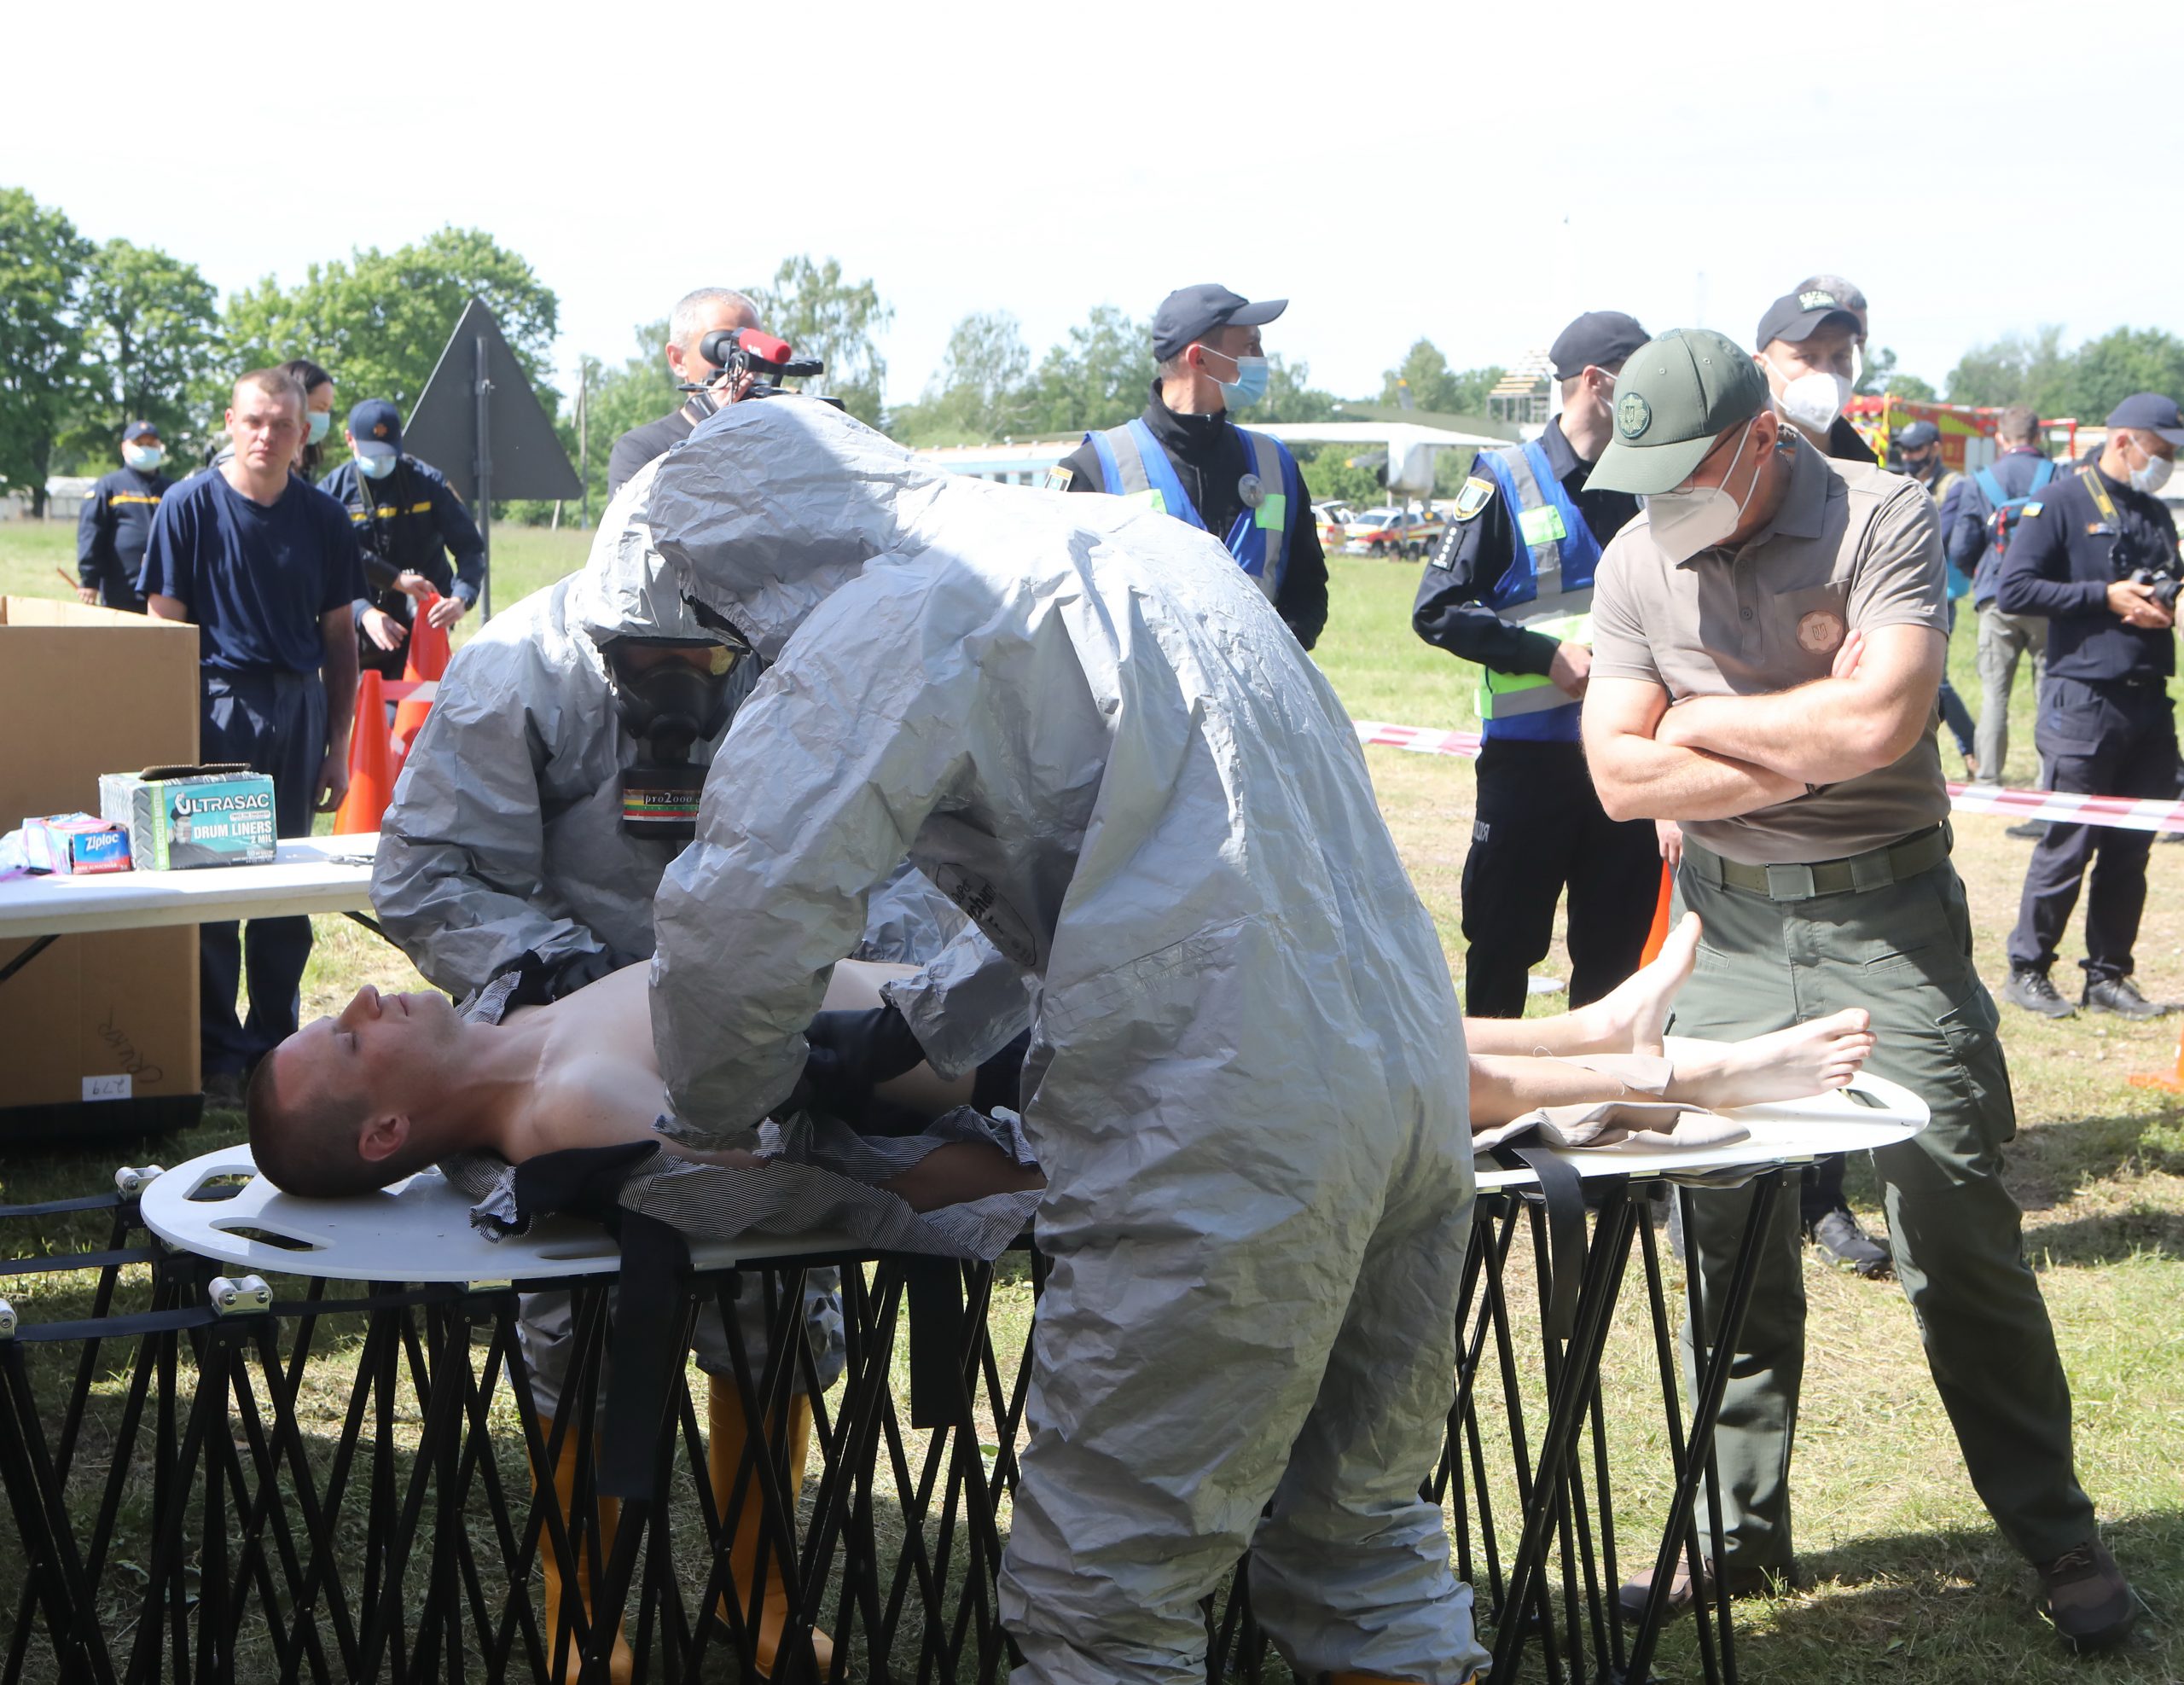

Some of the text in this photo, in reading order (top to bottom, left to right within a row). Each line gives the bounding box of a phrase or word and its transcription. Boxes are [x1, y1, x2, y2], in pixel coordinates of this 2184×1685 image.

[175, 792, 270, 815] ULTRASAC
[645, 792, 692, 805] pro2000
[194, 821, 272, 840] DRUM LINERS
[251, 834, 273, 844] 2 MIL
[85, 834, 119, 851] Ziploc
[92, 1078, 125, 1095] 279
